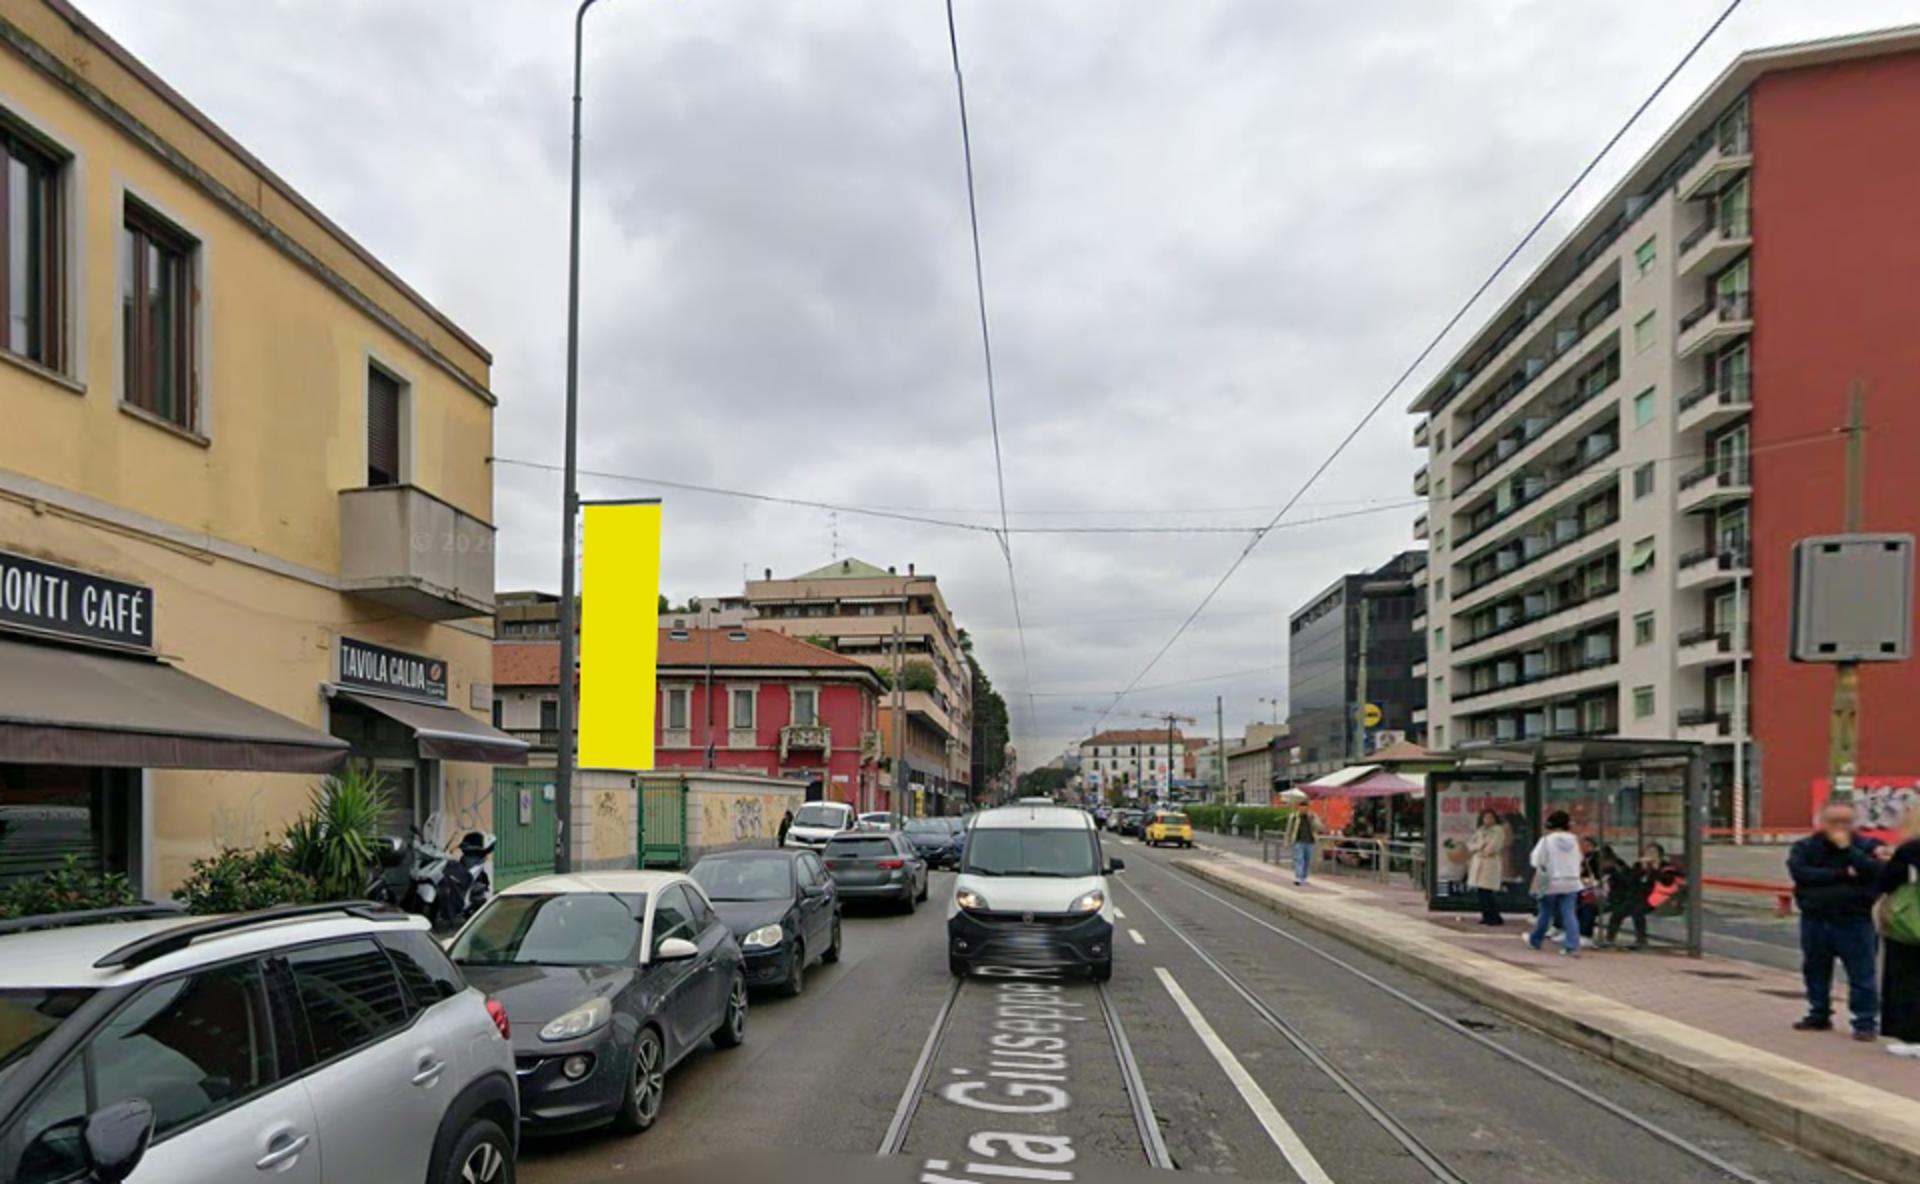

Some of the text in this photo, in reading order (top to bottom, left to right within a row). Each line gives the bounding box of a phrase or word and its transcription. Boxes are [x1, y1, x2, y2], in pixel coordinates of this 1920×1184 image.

[0, 565, 143, 635] ONTI CAFÉ
[342, 645, 388, 683] TAVOLA
[389, 657, 425, 690] CALDA
